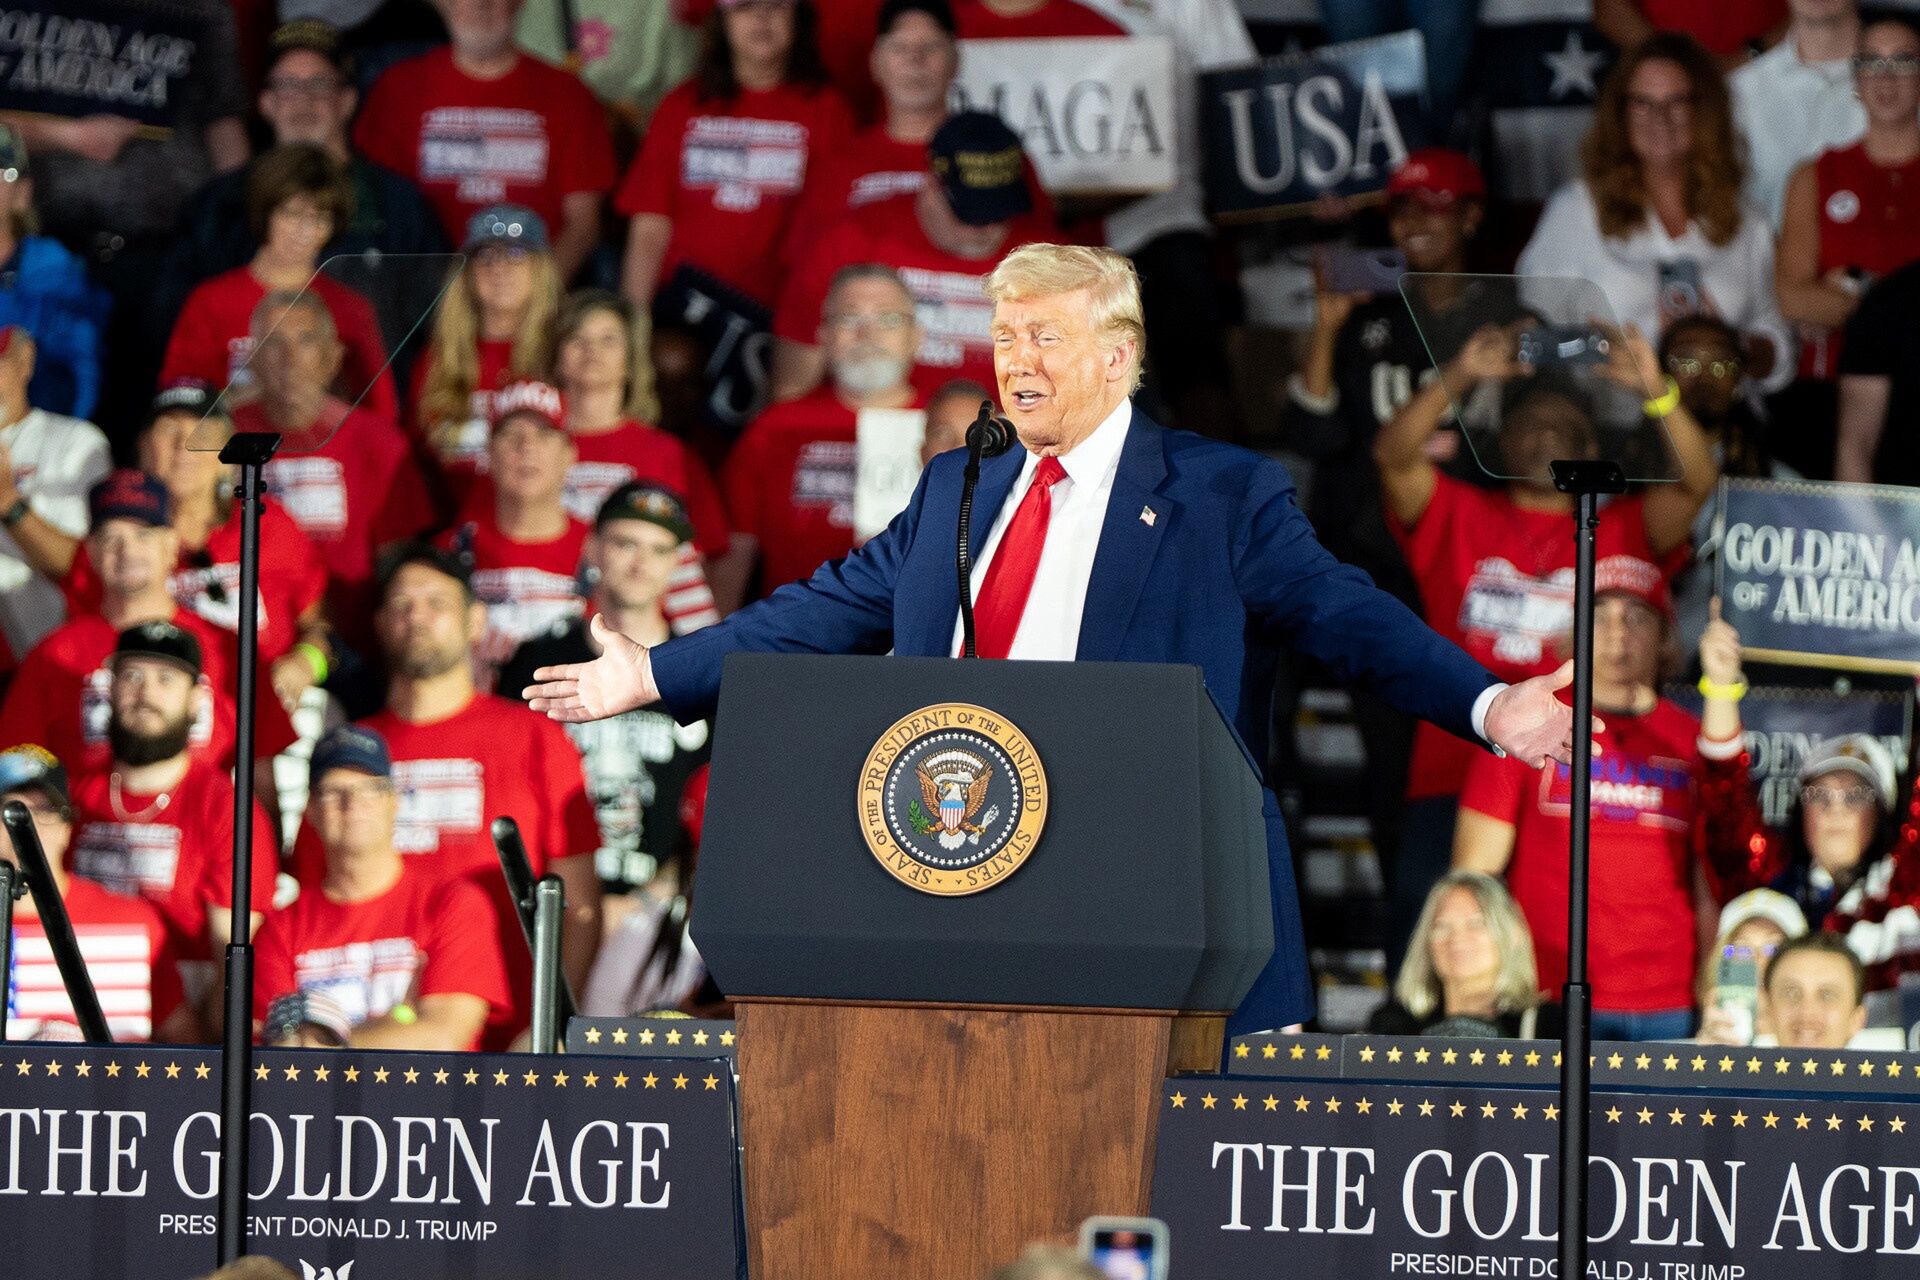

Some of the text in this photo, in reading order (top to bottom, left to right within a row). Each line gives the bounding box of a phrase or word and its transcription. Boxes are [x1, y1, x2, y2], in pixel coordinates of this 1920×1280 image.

[0, 9, 121, 58] OLDEN
[1221, 67, 1409, 194] USA
[1725, 522, 1886, 581] GOLDEN
[1732, 581, 1769, 612] OF
[865, 709, 1041, 887] SEAL OF THE PRESIDENT OF THE UNITED STATES
[0, 1108, 670, 1209] THE GOLDEN AGE
[1211, 1141, 1920, 1255] THE GOLDEN AGE
[159, 1214, 498, 1242] PRESENT DONALD J. TRUMP
[1391, 1252, 1523, 1277] PRESIDENT
[1529, 1258, 1633, 1280] DOALD
[1659, 1262, 1745, 1280] TRUMP
